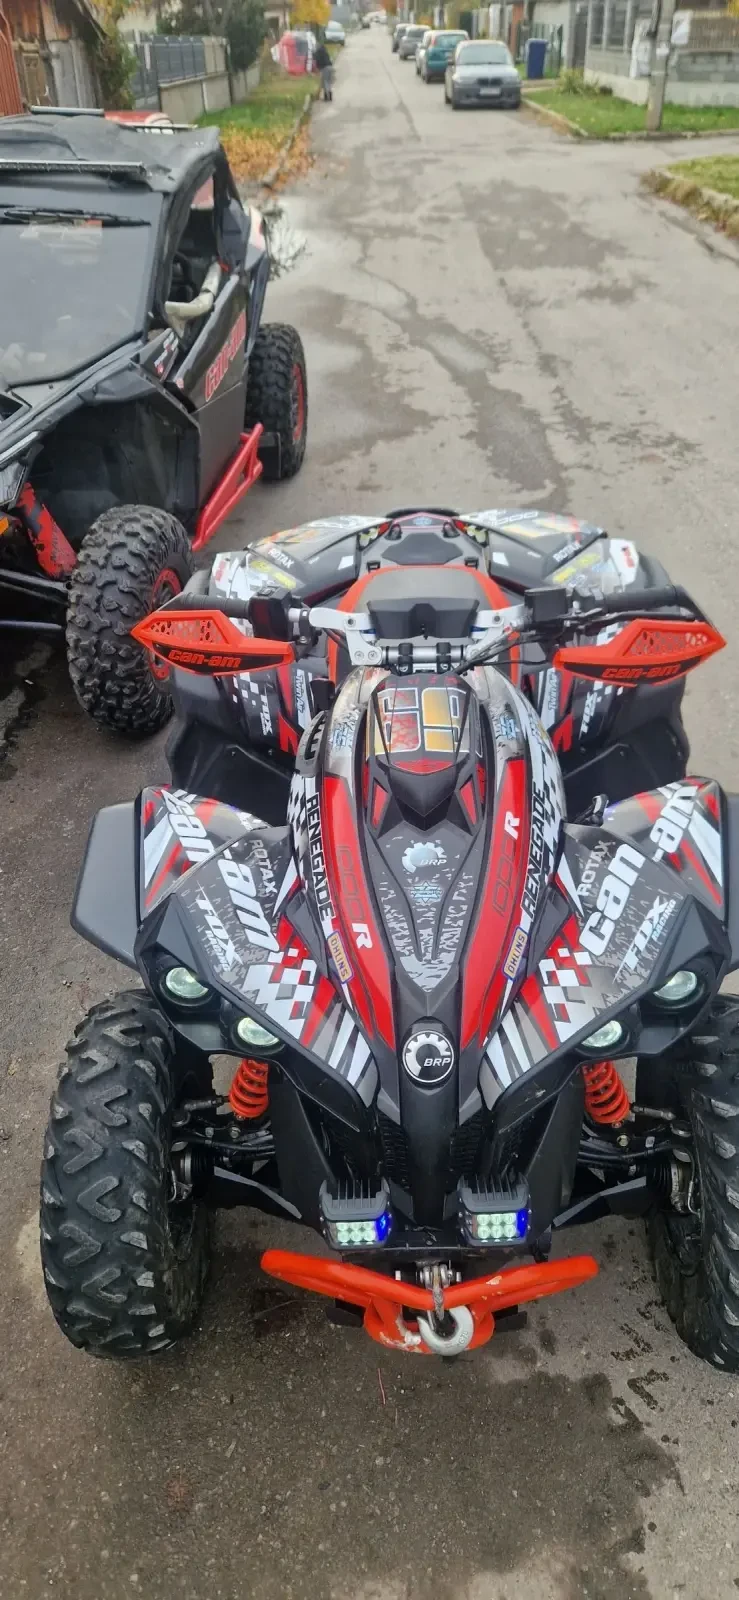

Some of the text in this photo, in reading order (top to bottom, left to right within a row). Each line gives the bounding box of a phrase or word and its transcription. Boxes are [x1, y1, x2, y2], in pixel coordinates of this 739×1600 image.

[268, 548, 295, 569] ROTAX
[168, 649, 242, 668] can-am
[602, 664, 682, 679] can-am
[161, 788, 280, 952] can-am
[249, 839, 278, 894] ROTAX
[306, 793, 335, 920] RENEGADE
[521, 780, 547, 920] RENEGADE
[577, 840, 614, 897] ROTAX
[579, 783, 698, 956] can-am
[196, 880, 244, 966] FOX
[612, 896, 669, 984] FOX
[423, 1057, 451, 1067] BRP
